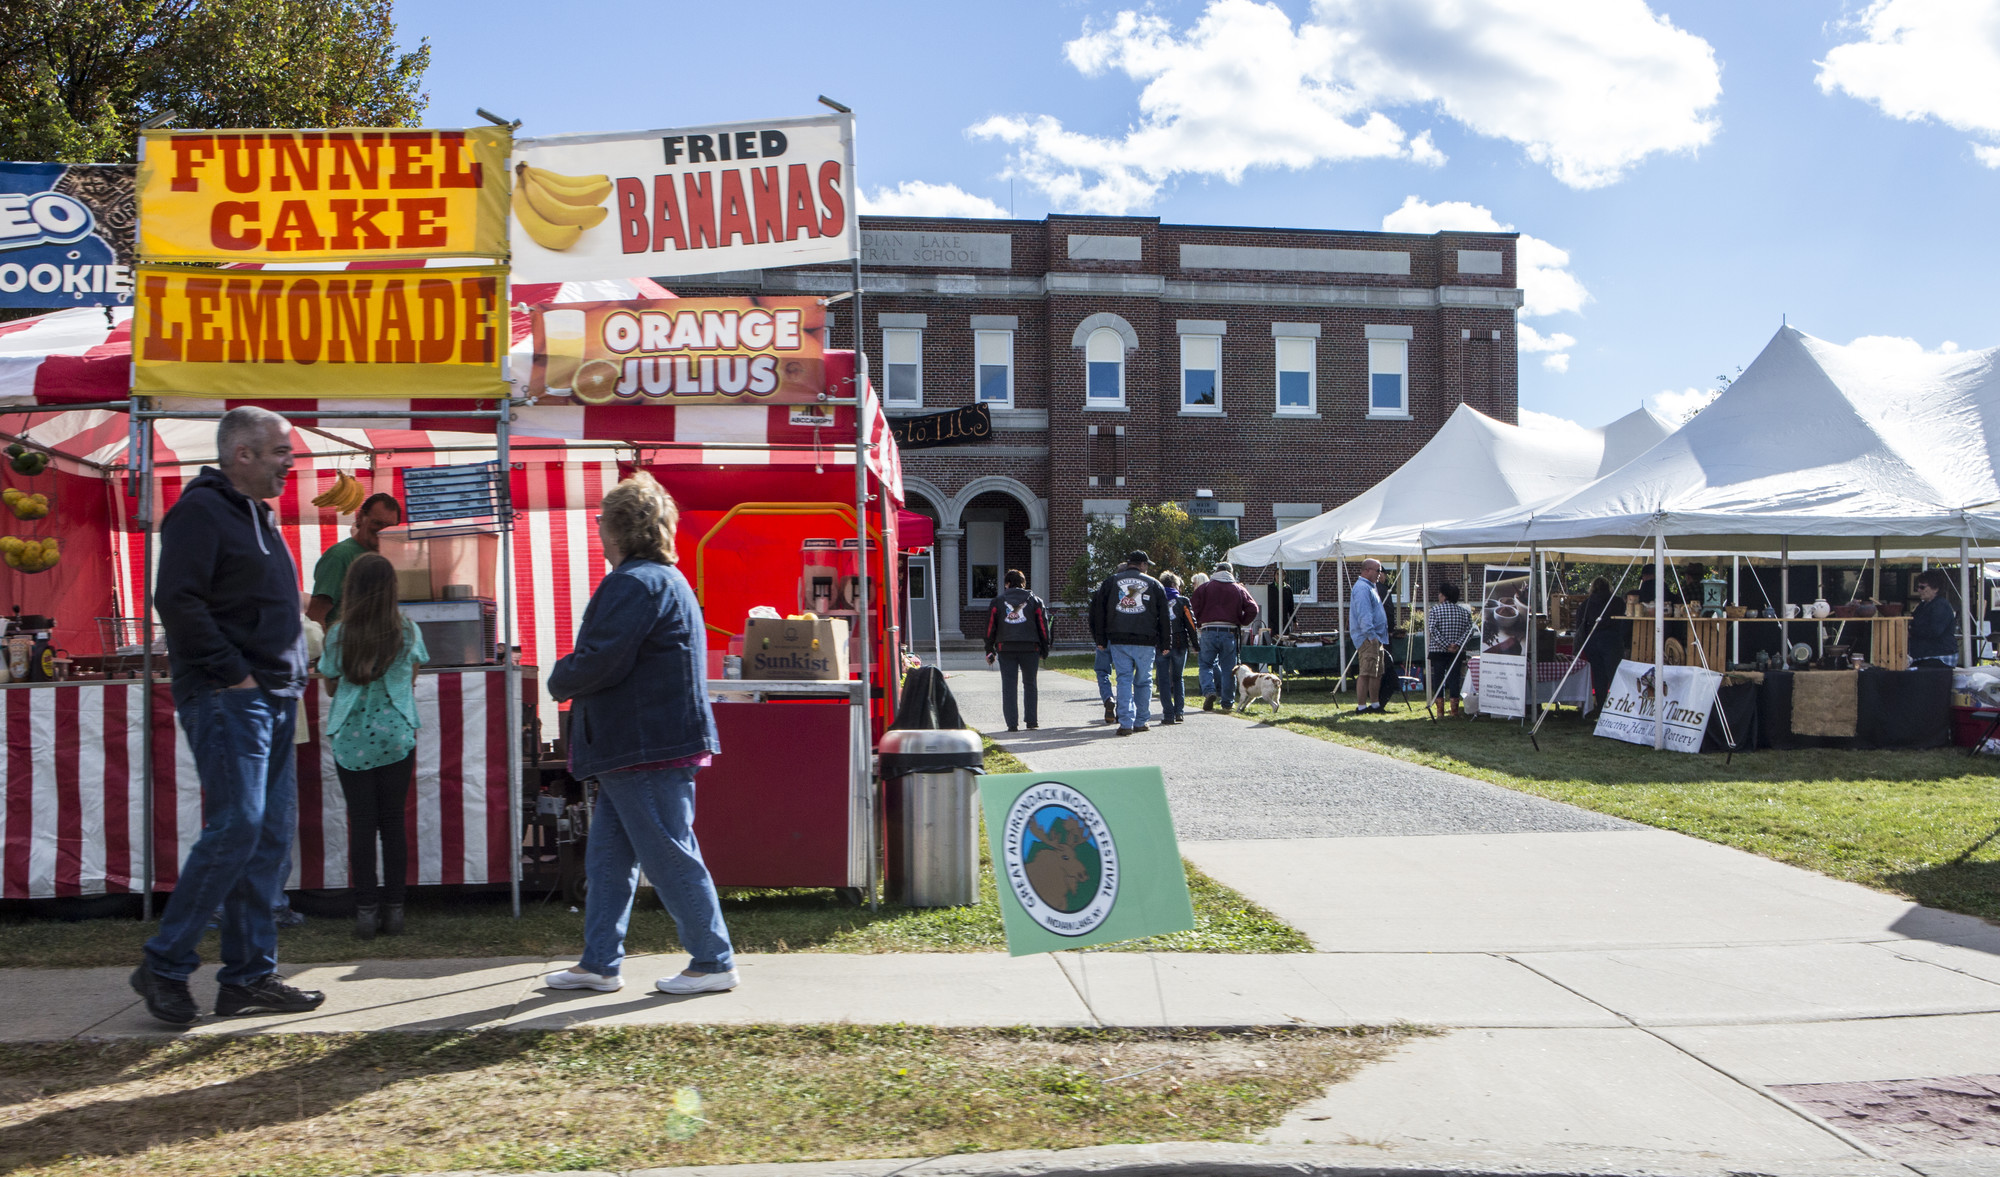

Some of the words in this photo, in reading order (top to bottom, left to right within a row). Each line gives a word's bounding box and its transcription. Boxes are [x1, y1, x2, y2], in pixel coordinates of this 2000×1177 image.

[171, 131, 483, 193] FUNNEL
[663, 130, 788, 165] FRIED
[210, 197, 448, 251] CAKE
[616, 160, 845, 254] BANANAS
[912, 249, 978, 263] SCHOOL
[921, 235, 961, 248] LAKE
[0, 263, 134, 293] OOKIE
[144, 277, 497, 365] LEMONADE
[602, 308, 801, 353] ORANGE
[613, 353, 780, 398] JULIUS
[902, 420, 926, 442] to
[754, 653, 829, 671] Sunkist
[1614, 693, 1635, 713] the
[1666, 700, 1705, 725] Turns
[1663, 727, 1697, 747] Pottery
[1008, 788, 1059, 857] ADIRONDACK
[1060, 790, 1101, 831] MOOSE
[1009, 860, 1037, 908] GREAT
[1096, 831, 1116, 898] FESTIVAL
